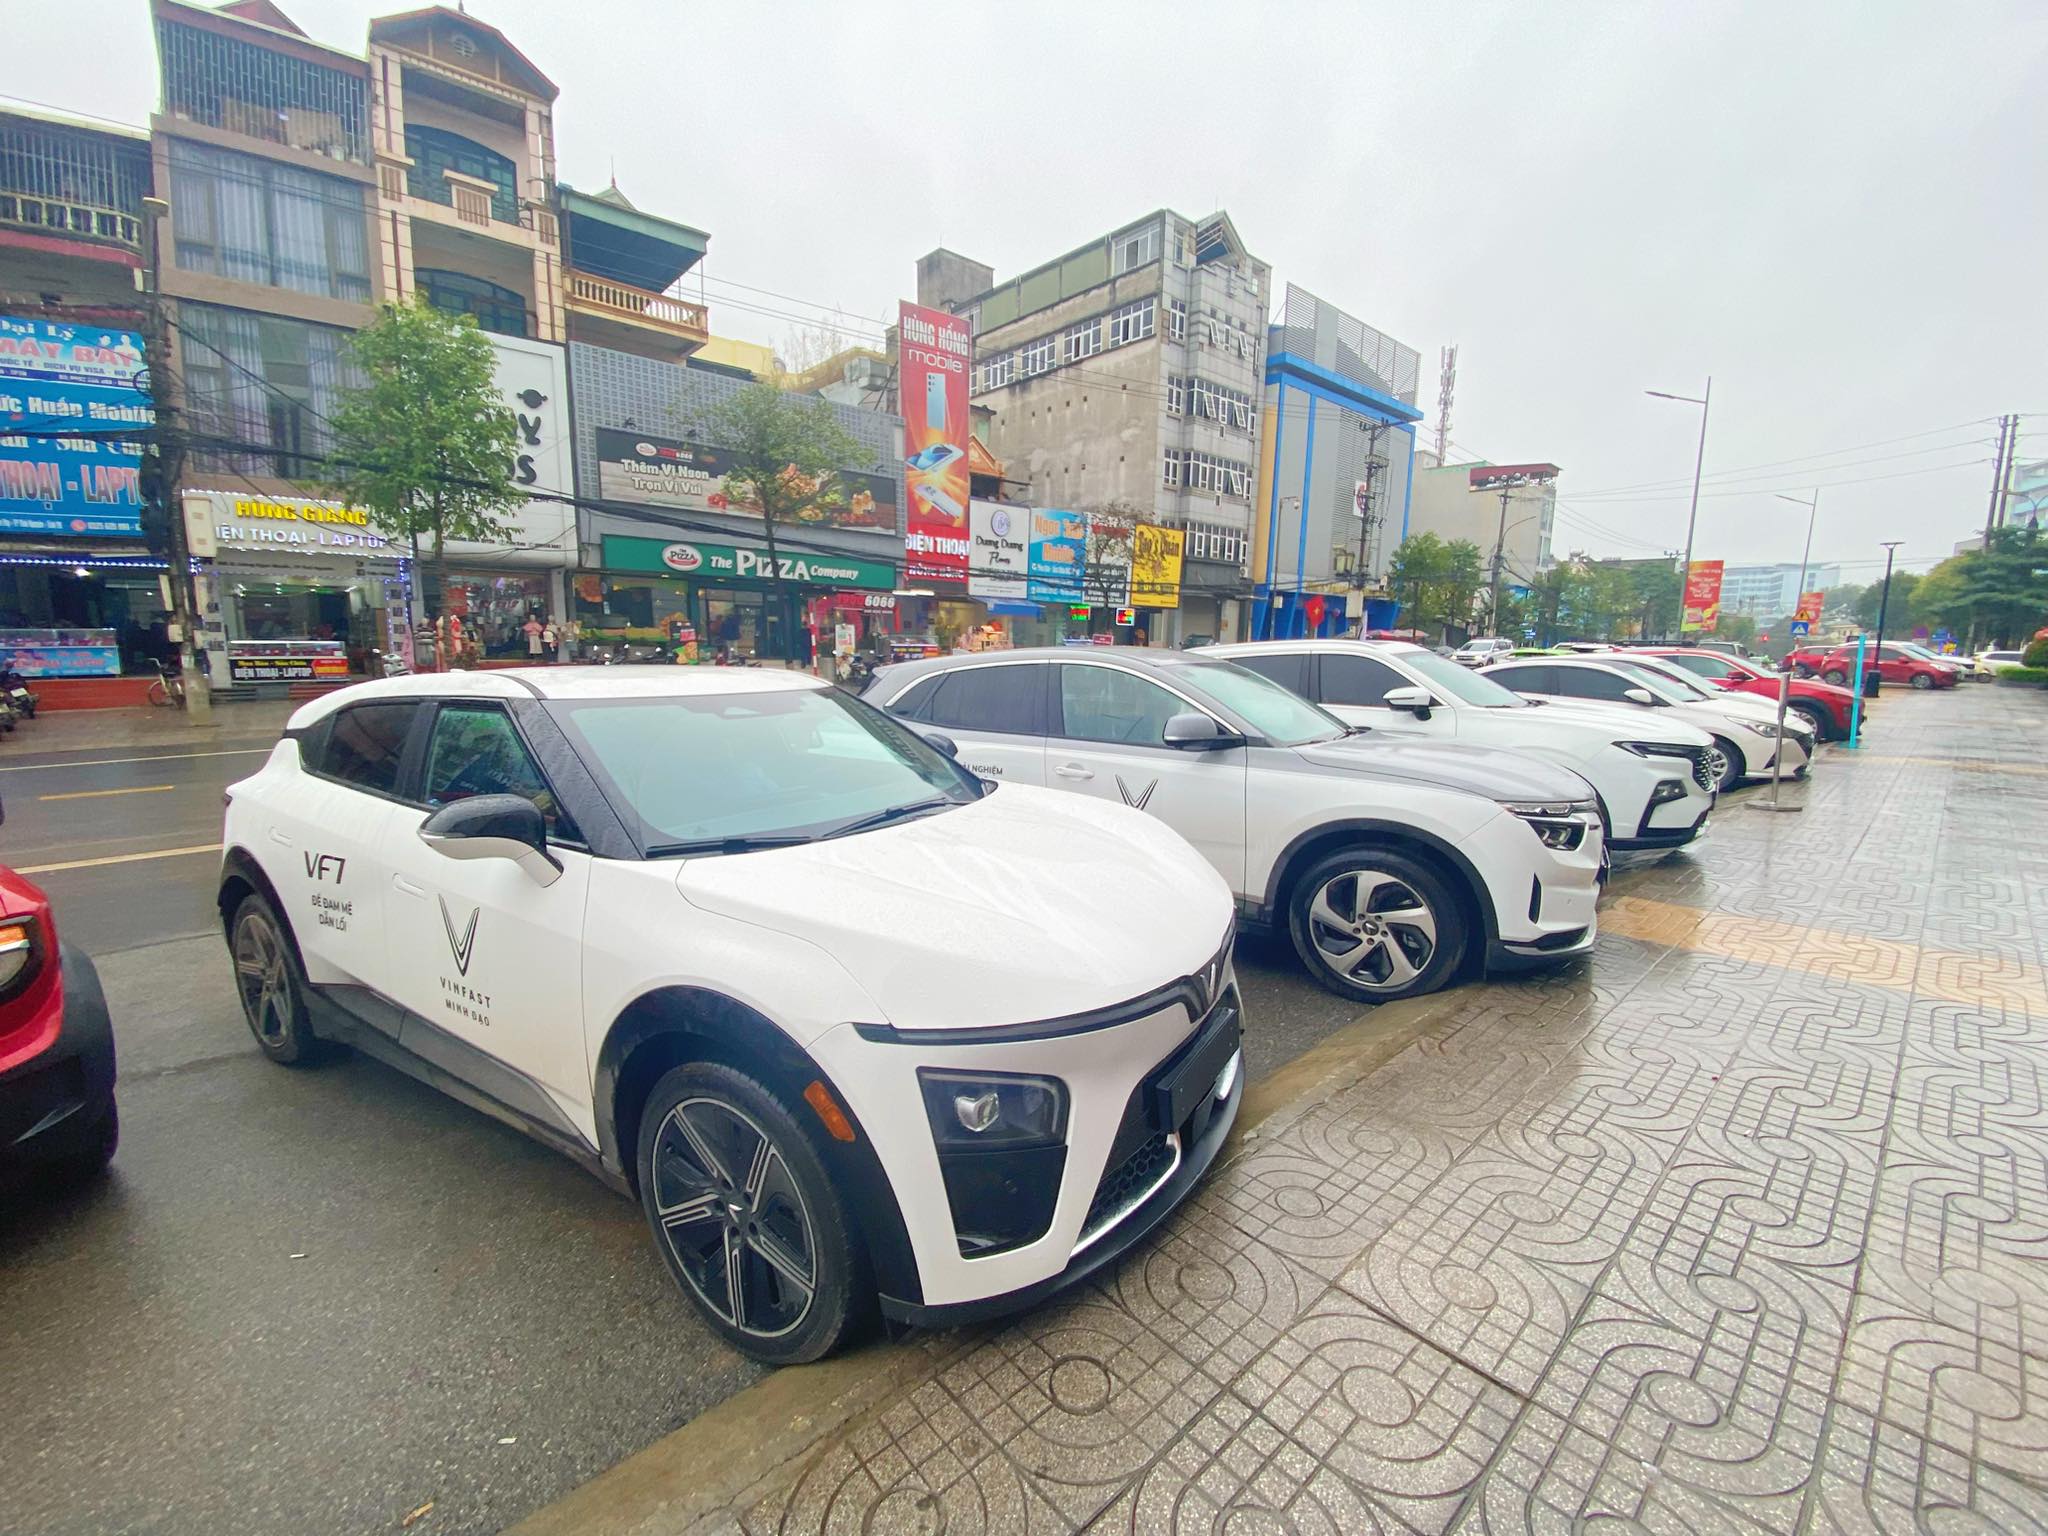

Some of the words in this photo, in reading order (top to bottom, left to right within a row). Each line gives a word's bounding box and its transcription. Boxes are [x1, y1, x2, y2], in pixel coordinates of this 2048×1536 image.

[903, 314, 935, 347] HÙNG
[938, 322, 969, 357] HỒNG
[73, 345, 136, 367] BAY
[908, 349, 963, 373] mobile
[0, 393, 22, 413] ức
[89, 401, 157, 425] Mobile
[621, 459, 660, 475] Thêm
[661, 463, 676, 478] Vị
[631, 476, 662, 493] Trọn
[681, 485, 703, 495] Vui
[235, 498, 297, 521] HÙNG
[302, 507, 367, 526] GIANG
[214, 522, 244, 543] IỆN
[249, 528, 308, 547] THOẠI
[711, 555, 733, 569] The
[735, 550, 811, 580] PIZZA
[810, 565, 860, 580] Company
[304, 850, 347, 885] VF7
[440, 976, 491, 1009] VINFAST
[445, 999, 469, 1017] MINH
